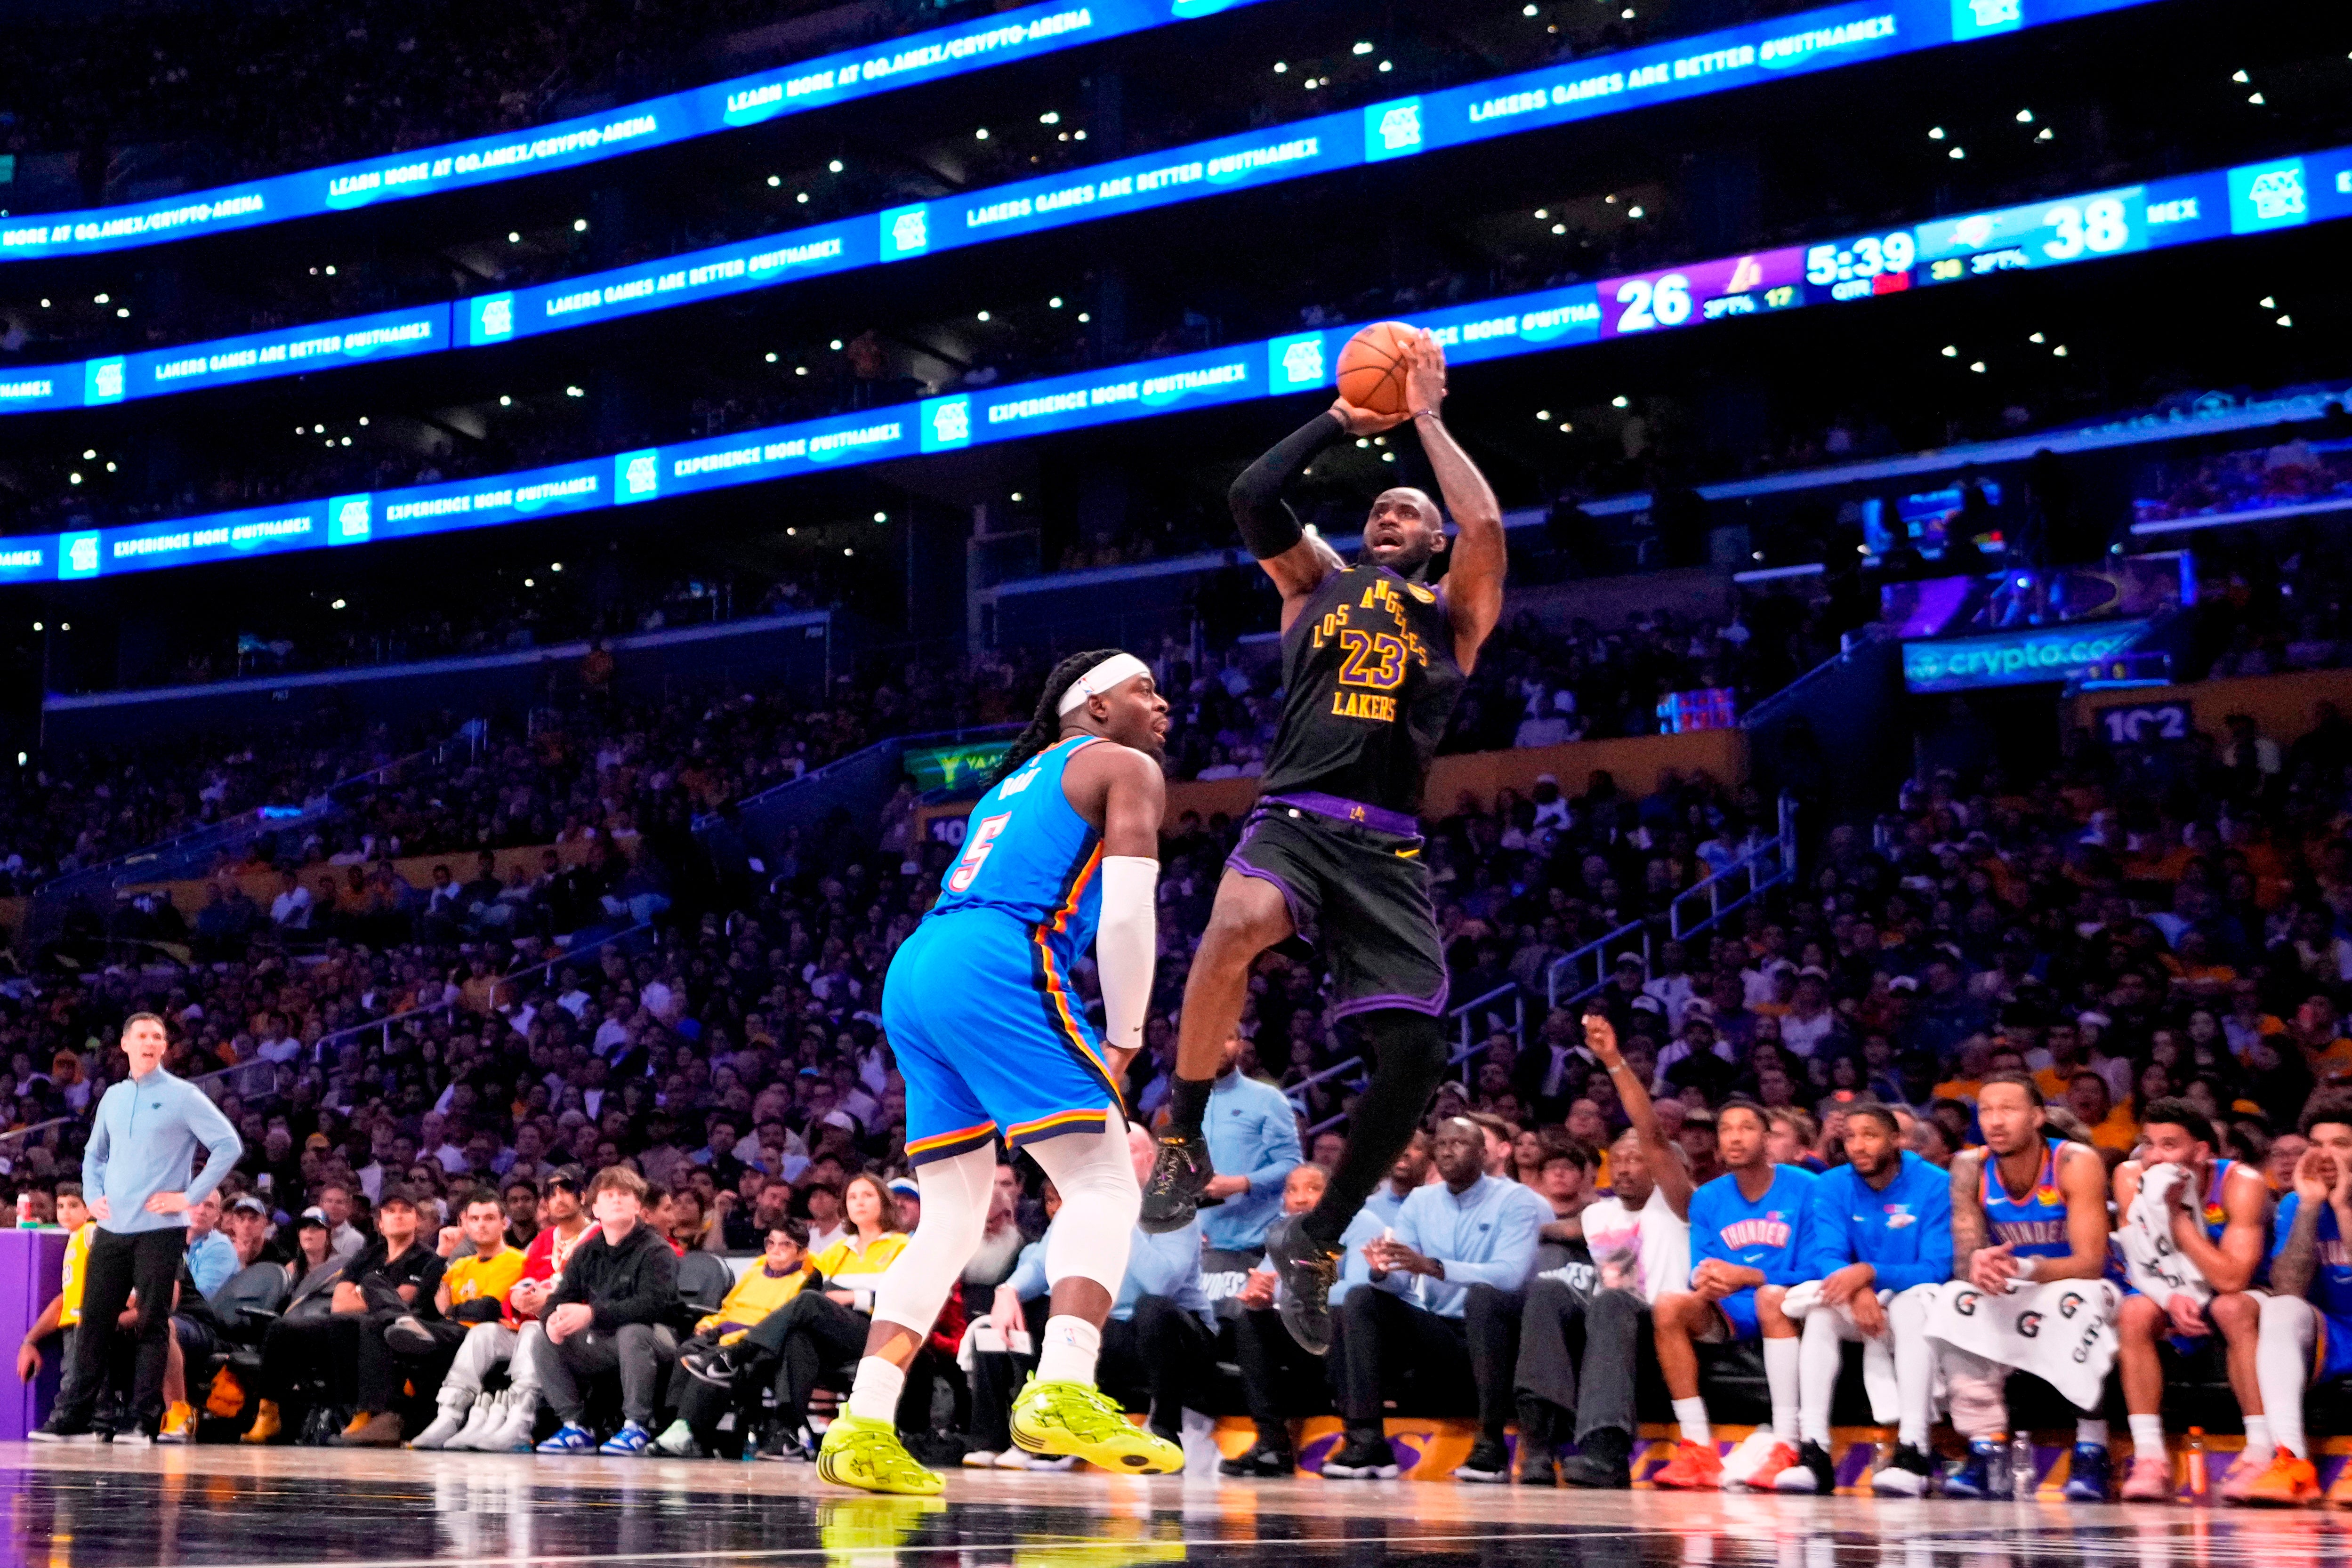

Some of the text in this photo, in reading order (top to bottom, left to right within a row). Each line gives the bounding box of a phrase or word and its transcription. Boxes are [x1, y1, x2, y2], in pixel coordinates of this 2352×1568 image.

[727, 83, 783, 113] LEARN
[786, 70, 835, 97] MORE
[838, 64, 860, 85] AT
[1470, 89, 1548, 122] LAKERS
[1552, 72, 1624, 105] GAMES
[1627, 63, 1670, 88] ARE
[1674, 45, 1755, 79] BETTER
[330, 171, 381, 197] LEARN
[384, 162, 429, 185] MORE
[431, 157, 452, 177] AT
[967, 198, 1032, 227] LAKERS
[1035, 185, 1095, 212] GAMES
[1098, 176, 1133, 199] ARE
[1136, 162, 1203, 192] BETTER
[2, 227, 48, 247] MORE
[50, 225, 72, 242] AT
[2042, 198, 2129, 259] 38
[1806, 232, 1915, 286] 5:39
[546, 289, 602, 316] LAKERS
[604, 278, 655, 303] GAMES
[656, 271, 686, 291] ARE
[689, 258, 745, 285] BETTER
[1617, 273, 1693, 333] 26
[1764, 285, 1795, 308] 17
[1463, 316, 1517, 341] MORE
[155, 358, 208, 380] LAKERS
[209, 349, 258, 371] GAMES
[258, 345, 286, 363] ARE
[289, 336, 342, 359] BETTER
[988, 390, 1087, 423] EXPERIENCE
[1091, 381, 1138, 405] MORE
[674, 446, 761, 476] EXPERIENCE
[764, 439, 806, 460] MORE
[386, 495, 471, 521] EXPERIENCE
[474, 490, 513, 509] MORE
[0, 550, 42, 567] AMEX
[113, 533, 190, 557] EXPERIENCE
[192, 527, 229, 546] MORE
[1313, 579, 1427, 667] LOS ANGELES
[1338, 629, 1408, 690] 23
[1949, 639, 2115, 675] crypto.co
[1331, 691, 1397, 722] LAKERS
[948, 810, 1013, 893] 5
[1720, 1218, 1791, 1251] THUNDER
